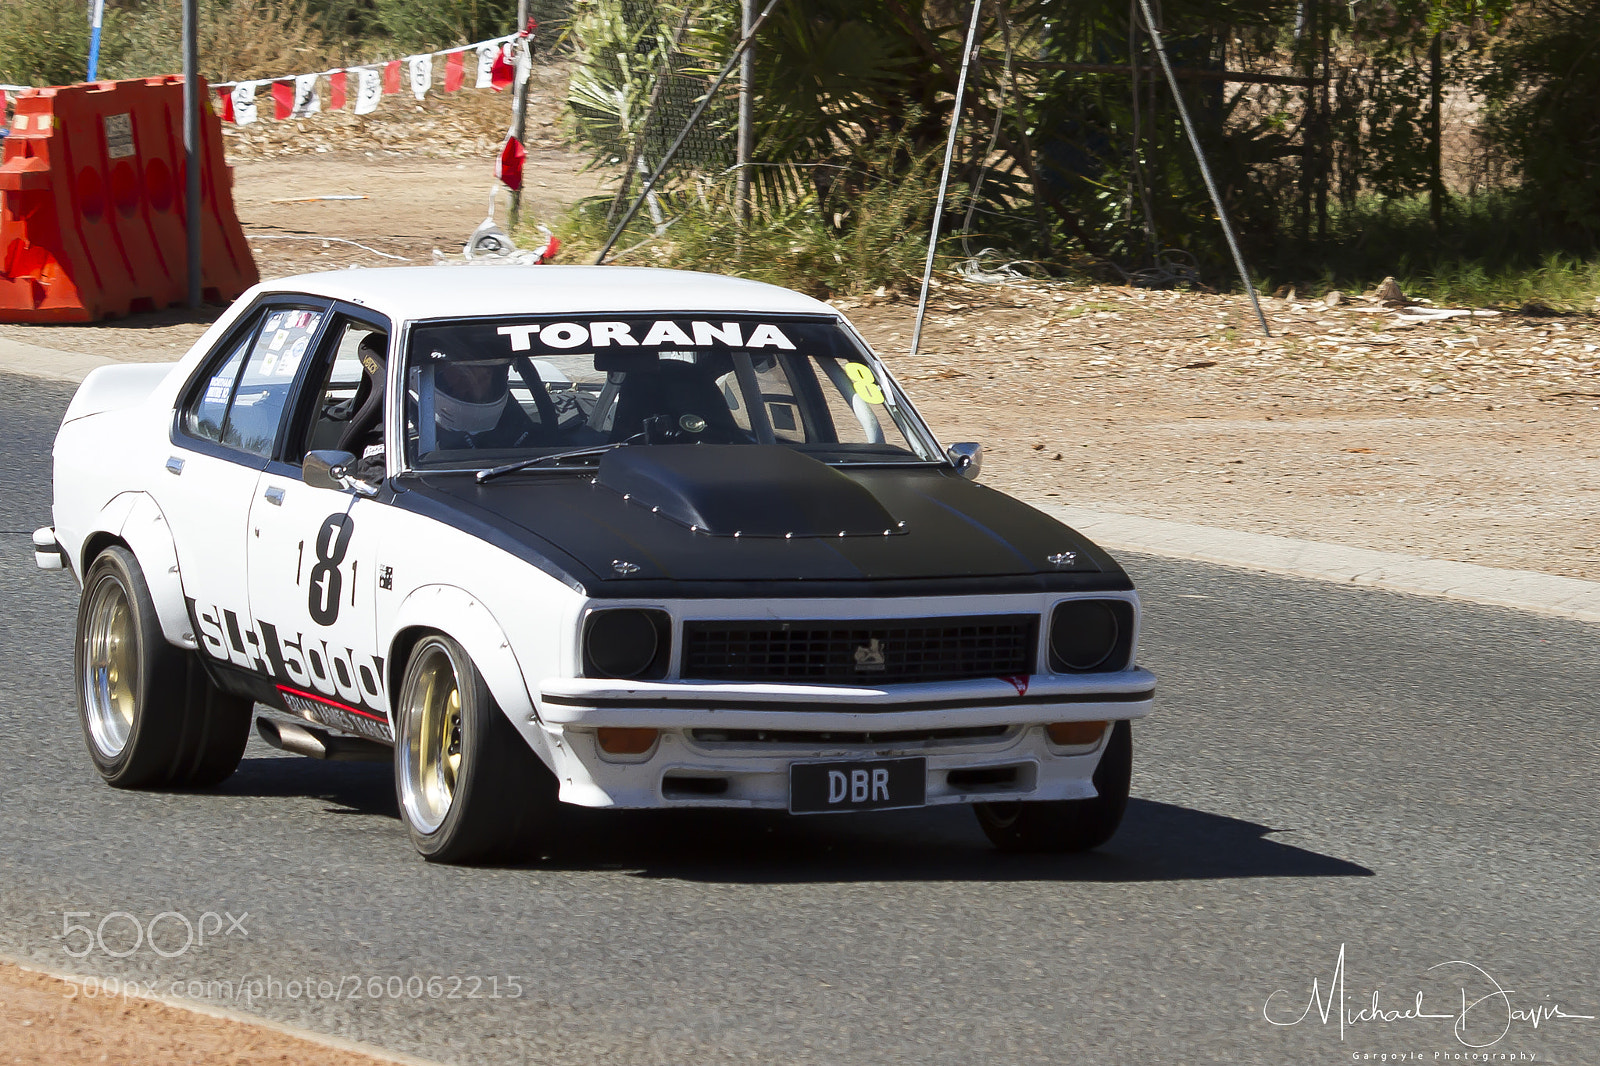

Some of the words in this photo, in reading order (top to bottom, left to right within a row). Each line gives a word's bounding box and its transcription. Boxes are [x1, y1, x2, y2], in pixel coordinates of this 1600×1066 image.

[497, 320, 796, 351] TORANA
[845, 362, 885, 404] 8
[281, 631, 387, 713] 5000
[828, 768, 890, 804] DBR
